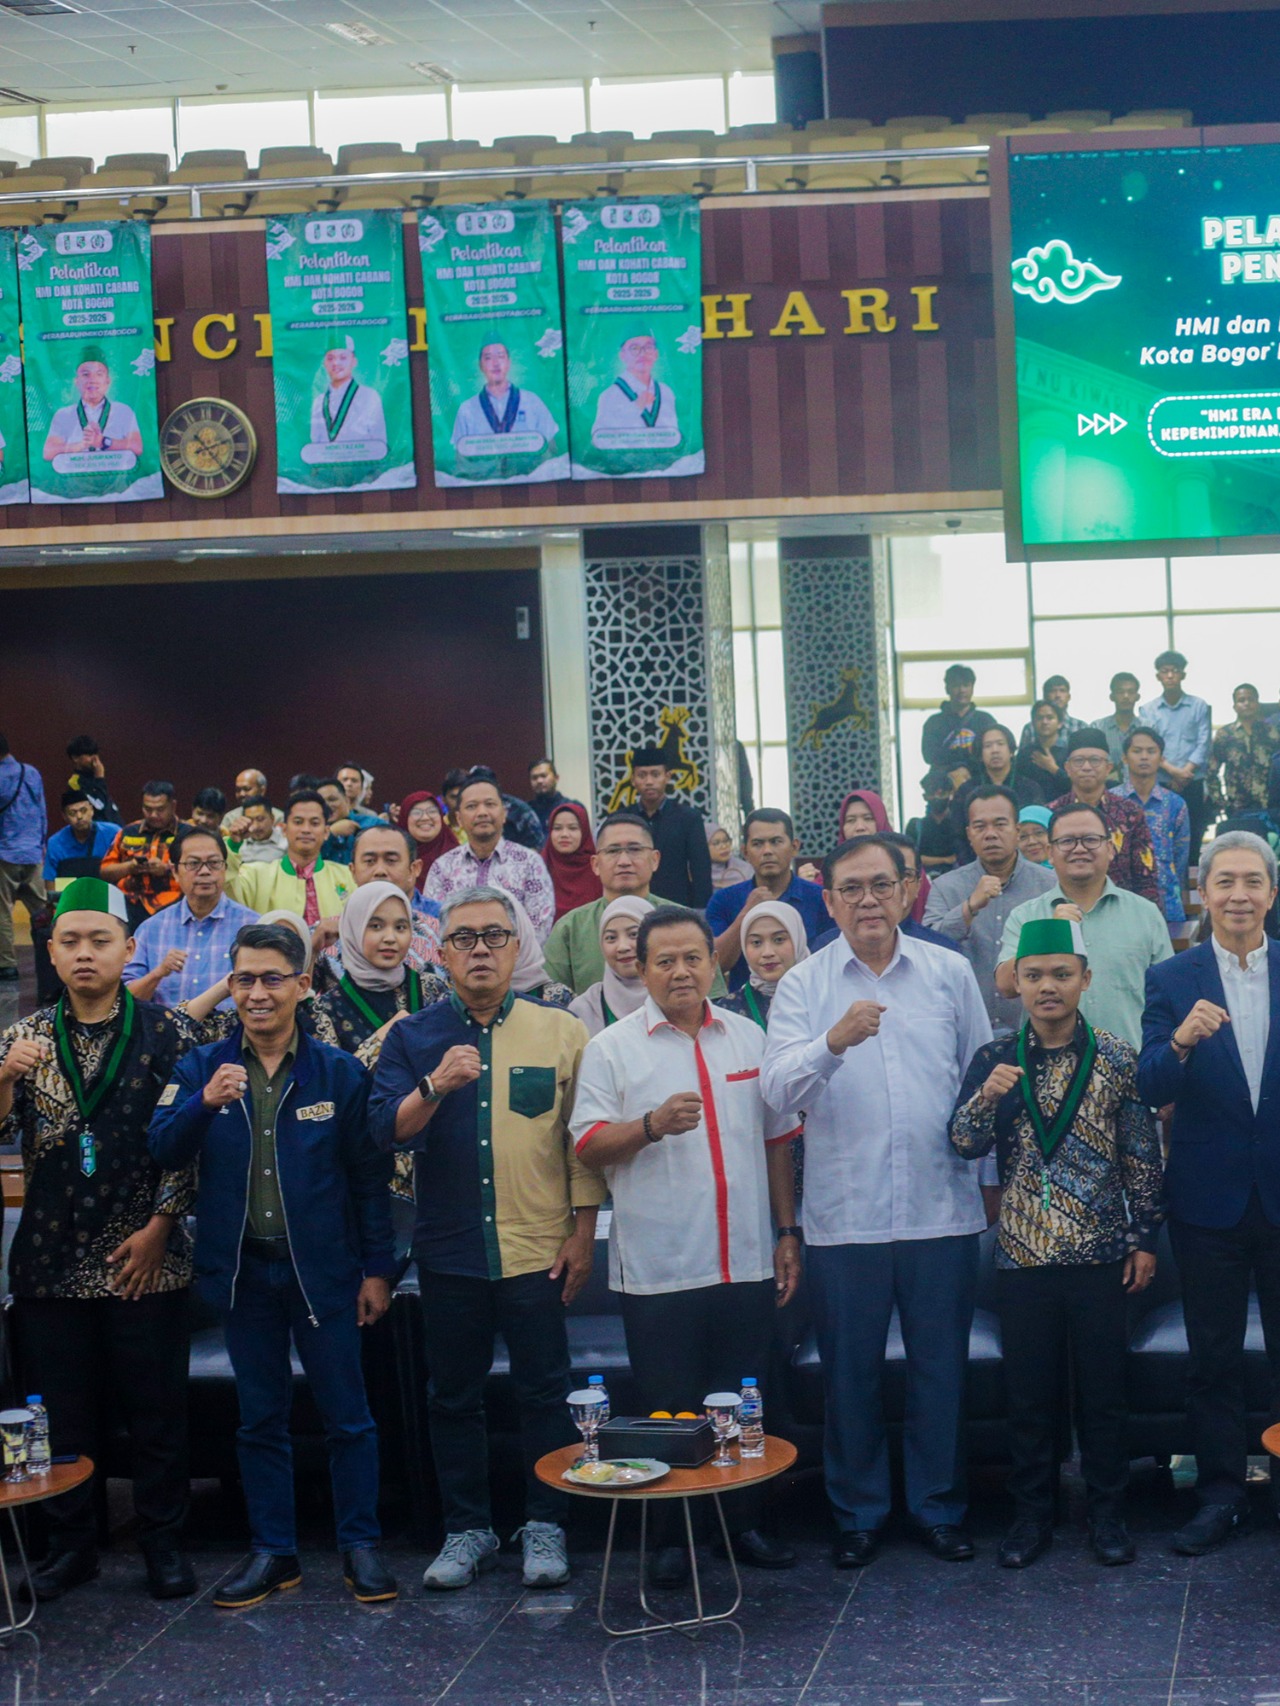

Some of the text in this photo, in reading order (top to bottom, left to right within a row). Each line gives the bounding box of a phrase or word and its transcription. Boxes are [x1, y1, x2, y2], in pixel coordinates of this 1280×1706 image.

[451, 242, 523, 261] Pelantikan
[594, 236, 667, 254] Pelantikan
[299, 251, 370, 269] Pelantikan
[50, 262, 119, 280] Pelantikan
[284, 271, 391, 288] HMI DAN KOHATI CABANG
[35, 281, 139, 298] HMI DAN KOHATI CABANG
[311, 286, 364, 300] KOTA BOGOR
[62, 297, 114, 310] KOTA BOGOR
[68, 314, 107, 324] 2025-2026
[1175, 317, 1220, 337] HMI
[1226, 315, 1271, 334] dan
[1140, 345, 1194, 366] Kota
[1201, 344, 1271, 367] Bogor
[1242, 406, 1273, 422] ERA
